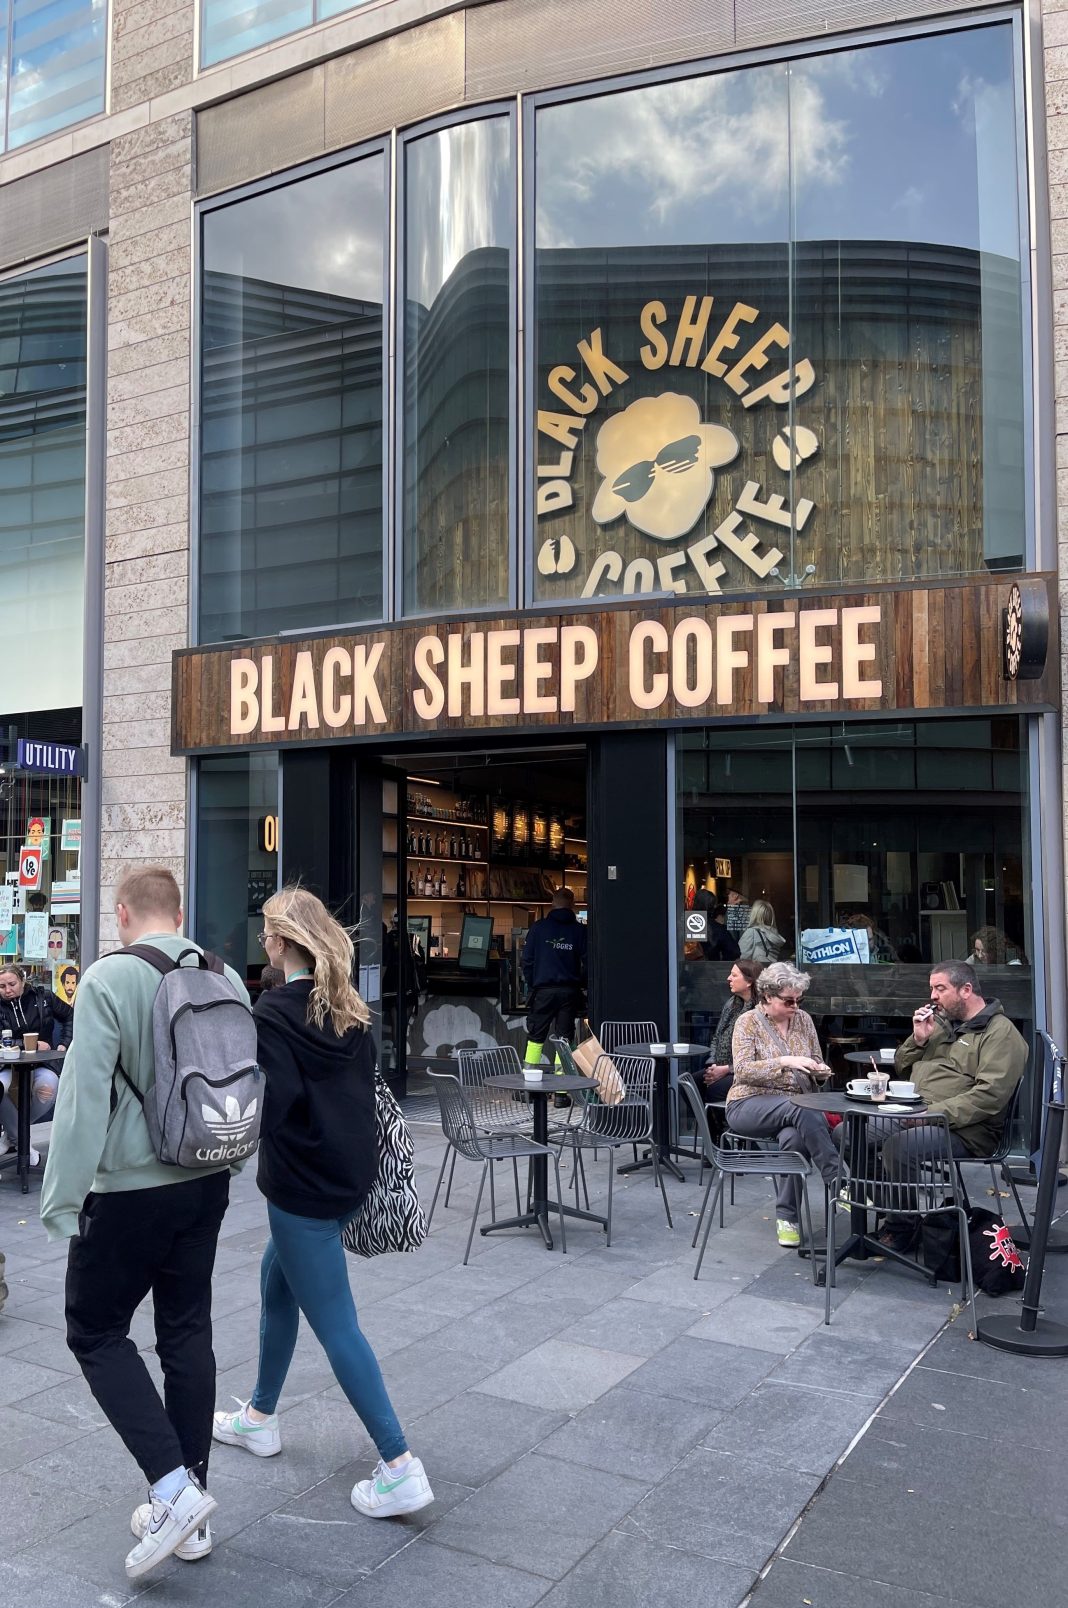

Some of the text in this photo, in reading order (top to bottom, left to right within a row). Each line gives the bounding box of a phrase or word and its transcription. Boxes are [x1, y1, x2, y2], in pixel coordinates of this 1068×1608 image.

[537, 295, 816, 515] BLACK SHEEP
[580, 480, 815, 597] COFFEE
[230, 605, 882, 735] BLACK SHEEP COFFEE
[25, 742, 76, 771] UTILITY
